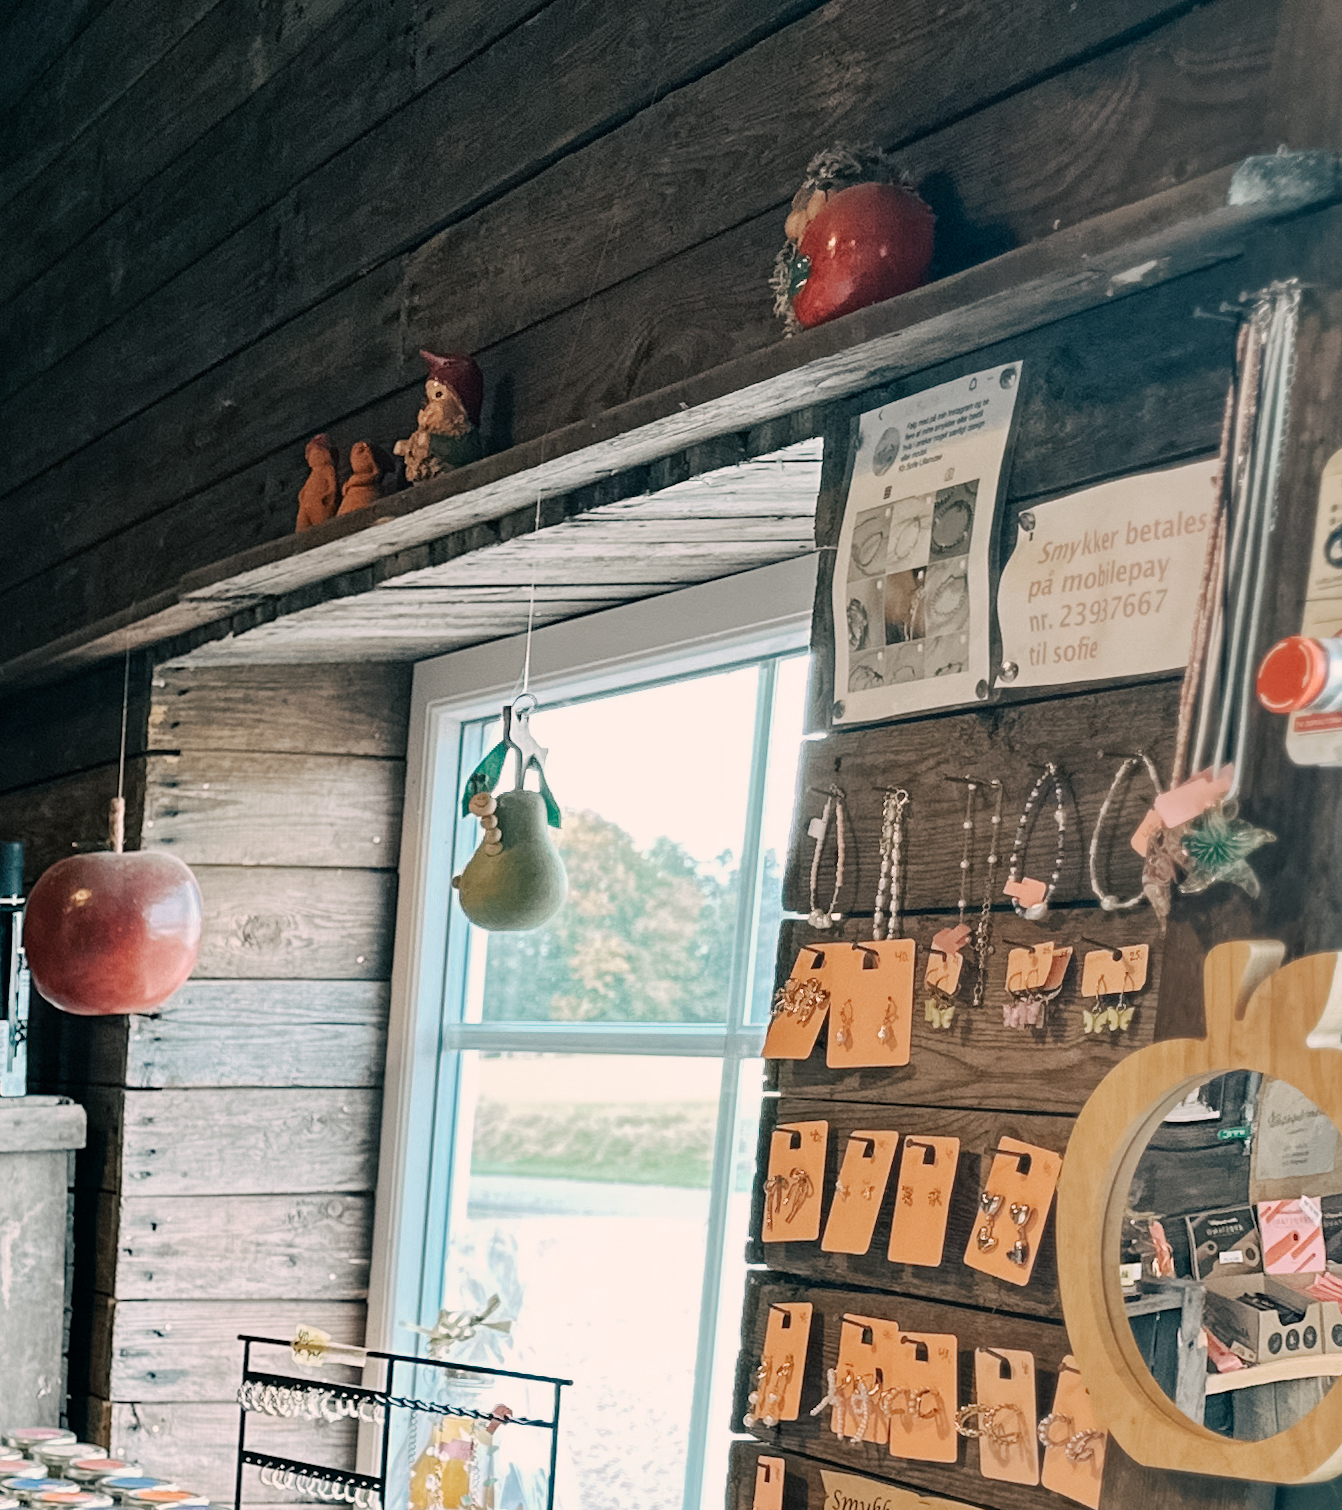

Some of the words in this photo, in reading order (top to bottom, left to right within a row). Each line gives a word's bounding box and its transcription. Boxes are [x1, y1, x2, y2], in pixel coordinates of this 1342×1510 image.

[1037, 529, 1119, 565] Smykker
[1125, 511, 1209, 546] betales
[1027, 569, 1054, 603] på
[1061, 556, 1171, 594] mobilepay
[1029, 611, 1054, 633] nr.
[1059, 588, 1168, 629] 23937667
[1028, 643, 1047, 667] til
[1053, 635, 1099, 665] sofie
